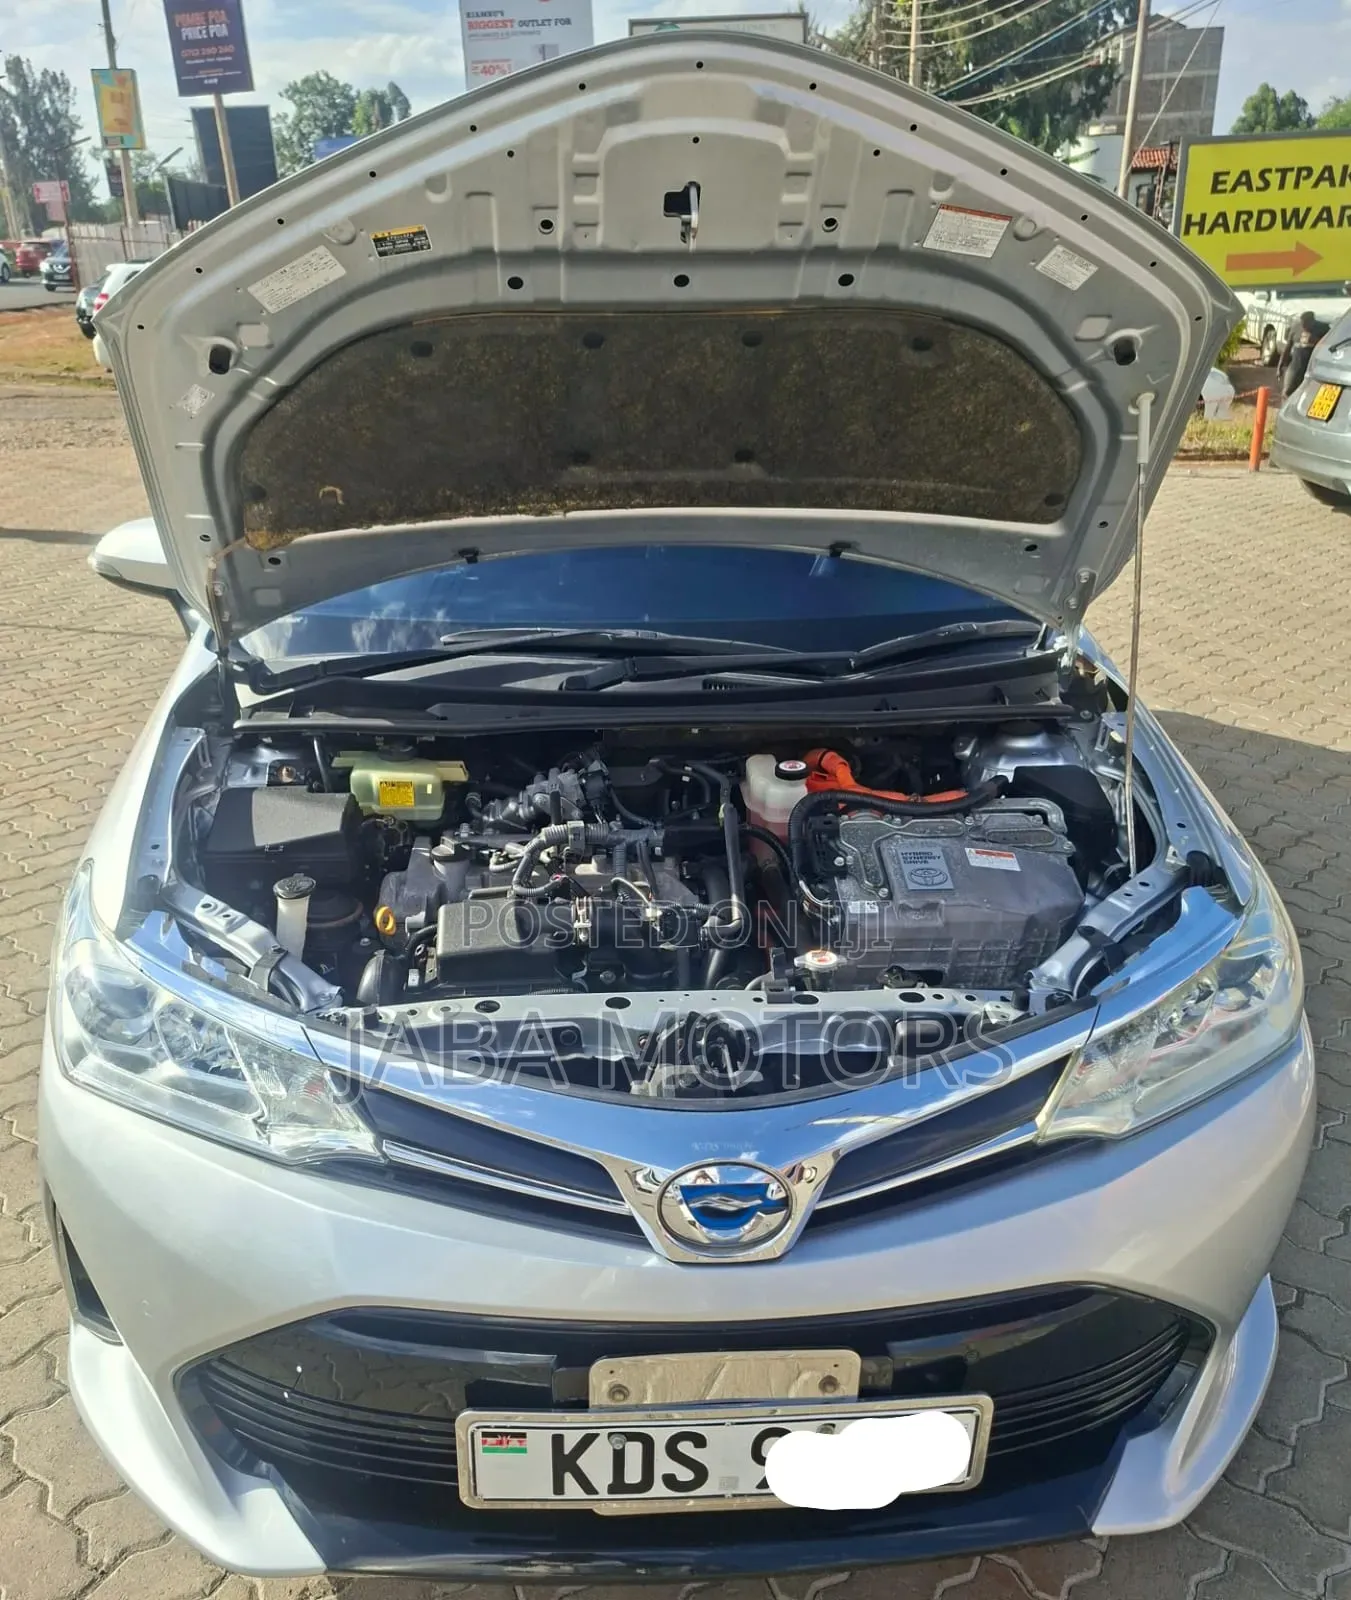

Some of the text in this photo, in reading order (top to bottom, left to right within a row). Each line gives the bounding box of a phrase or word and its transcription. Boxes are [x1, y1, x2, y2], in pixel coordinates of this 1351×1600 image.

[467, 18, 572, 31] BIGGEST OUTLET FOR
[1183, 204, 1351, 236] HARDWAR
[551, 1432, 709, 1496] KDS
